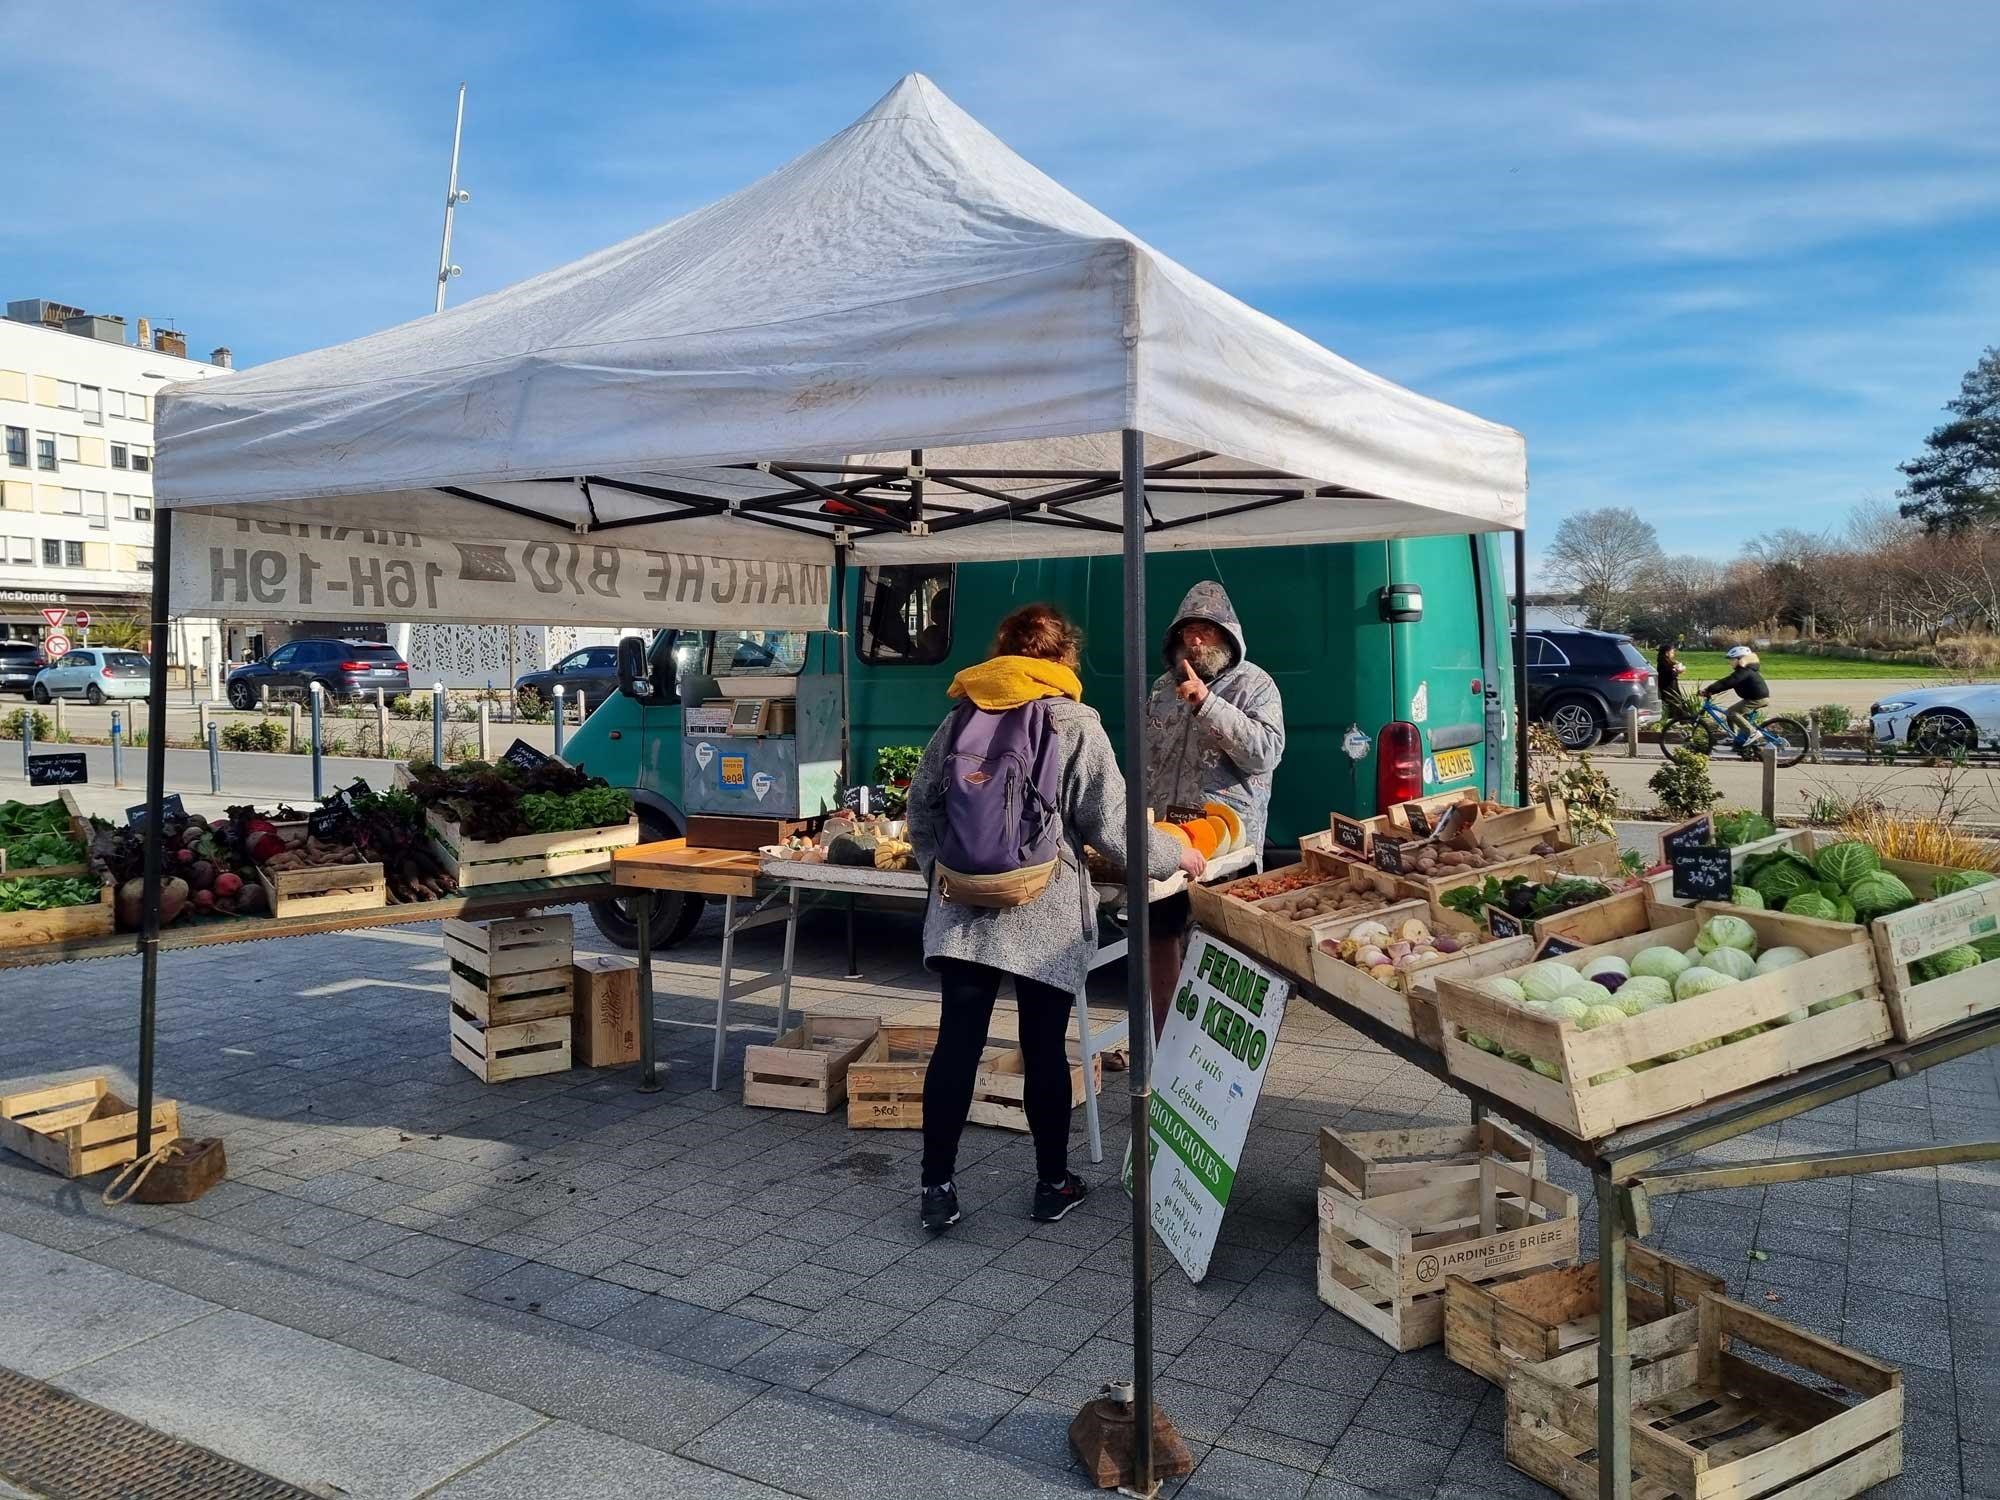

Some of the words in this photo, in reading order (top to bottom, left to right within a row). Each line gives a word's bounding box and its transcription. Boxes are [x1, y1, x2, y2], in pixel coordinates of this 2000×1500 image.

[1197, 943, 1270, 1018] FERME
[1176, 980, 1199, 1021] de
[1200, 996, 1267, 1071] KERIO
[1188, 1043, 1224, 1083] Fruits
[1194, 1079, 1203, 1092] &
[1170, 1076, 1220, 1131] Légumes
[1150, 1098, 1222, 1184] BIOLOGIQUES
[1321, 1196, 1334, 1220] 23
[1442, 1245, 1495, 1266] JARDINS
[1499, 1240, 1515, 1253] DE
[1520, 1229, 1562, 1249] BRIÈRE
